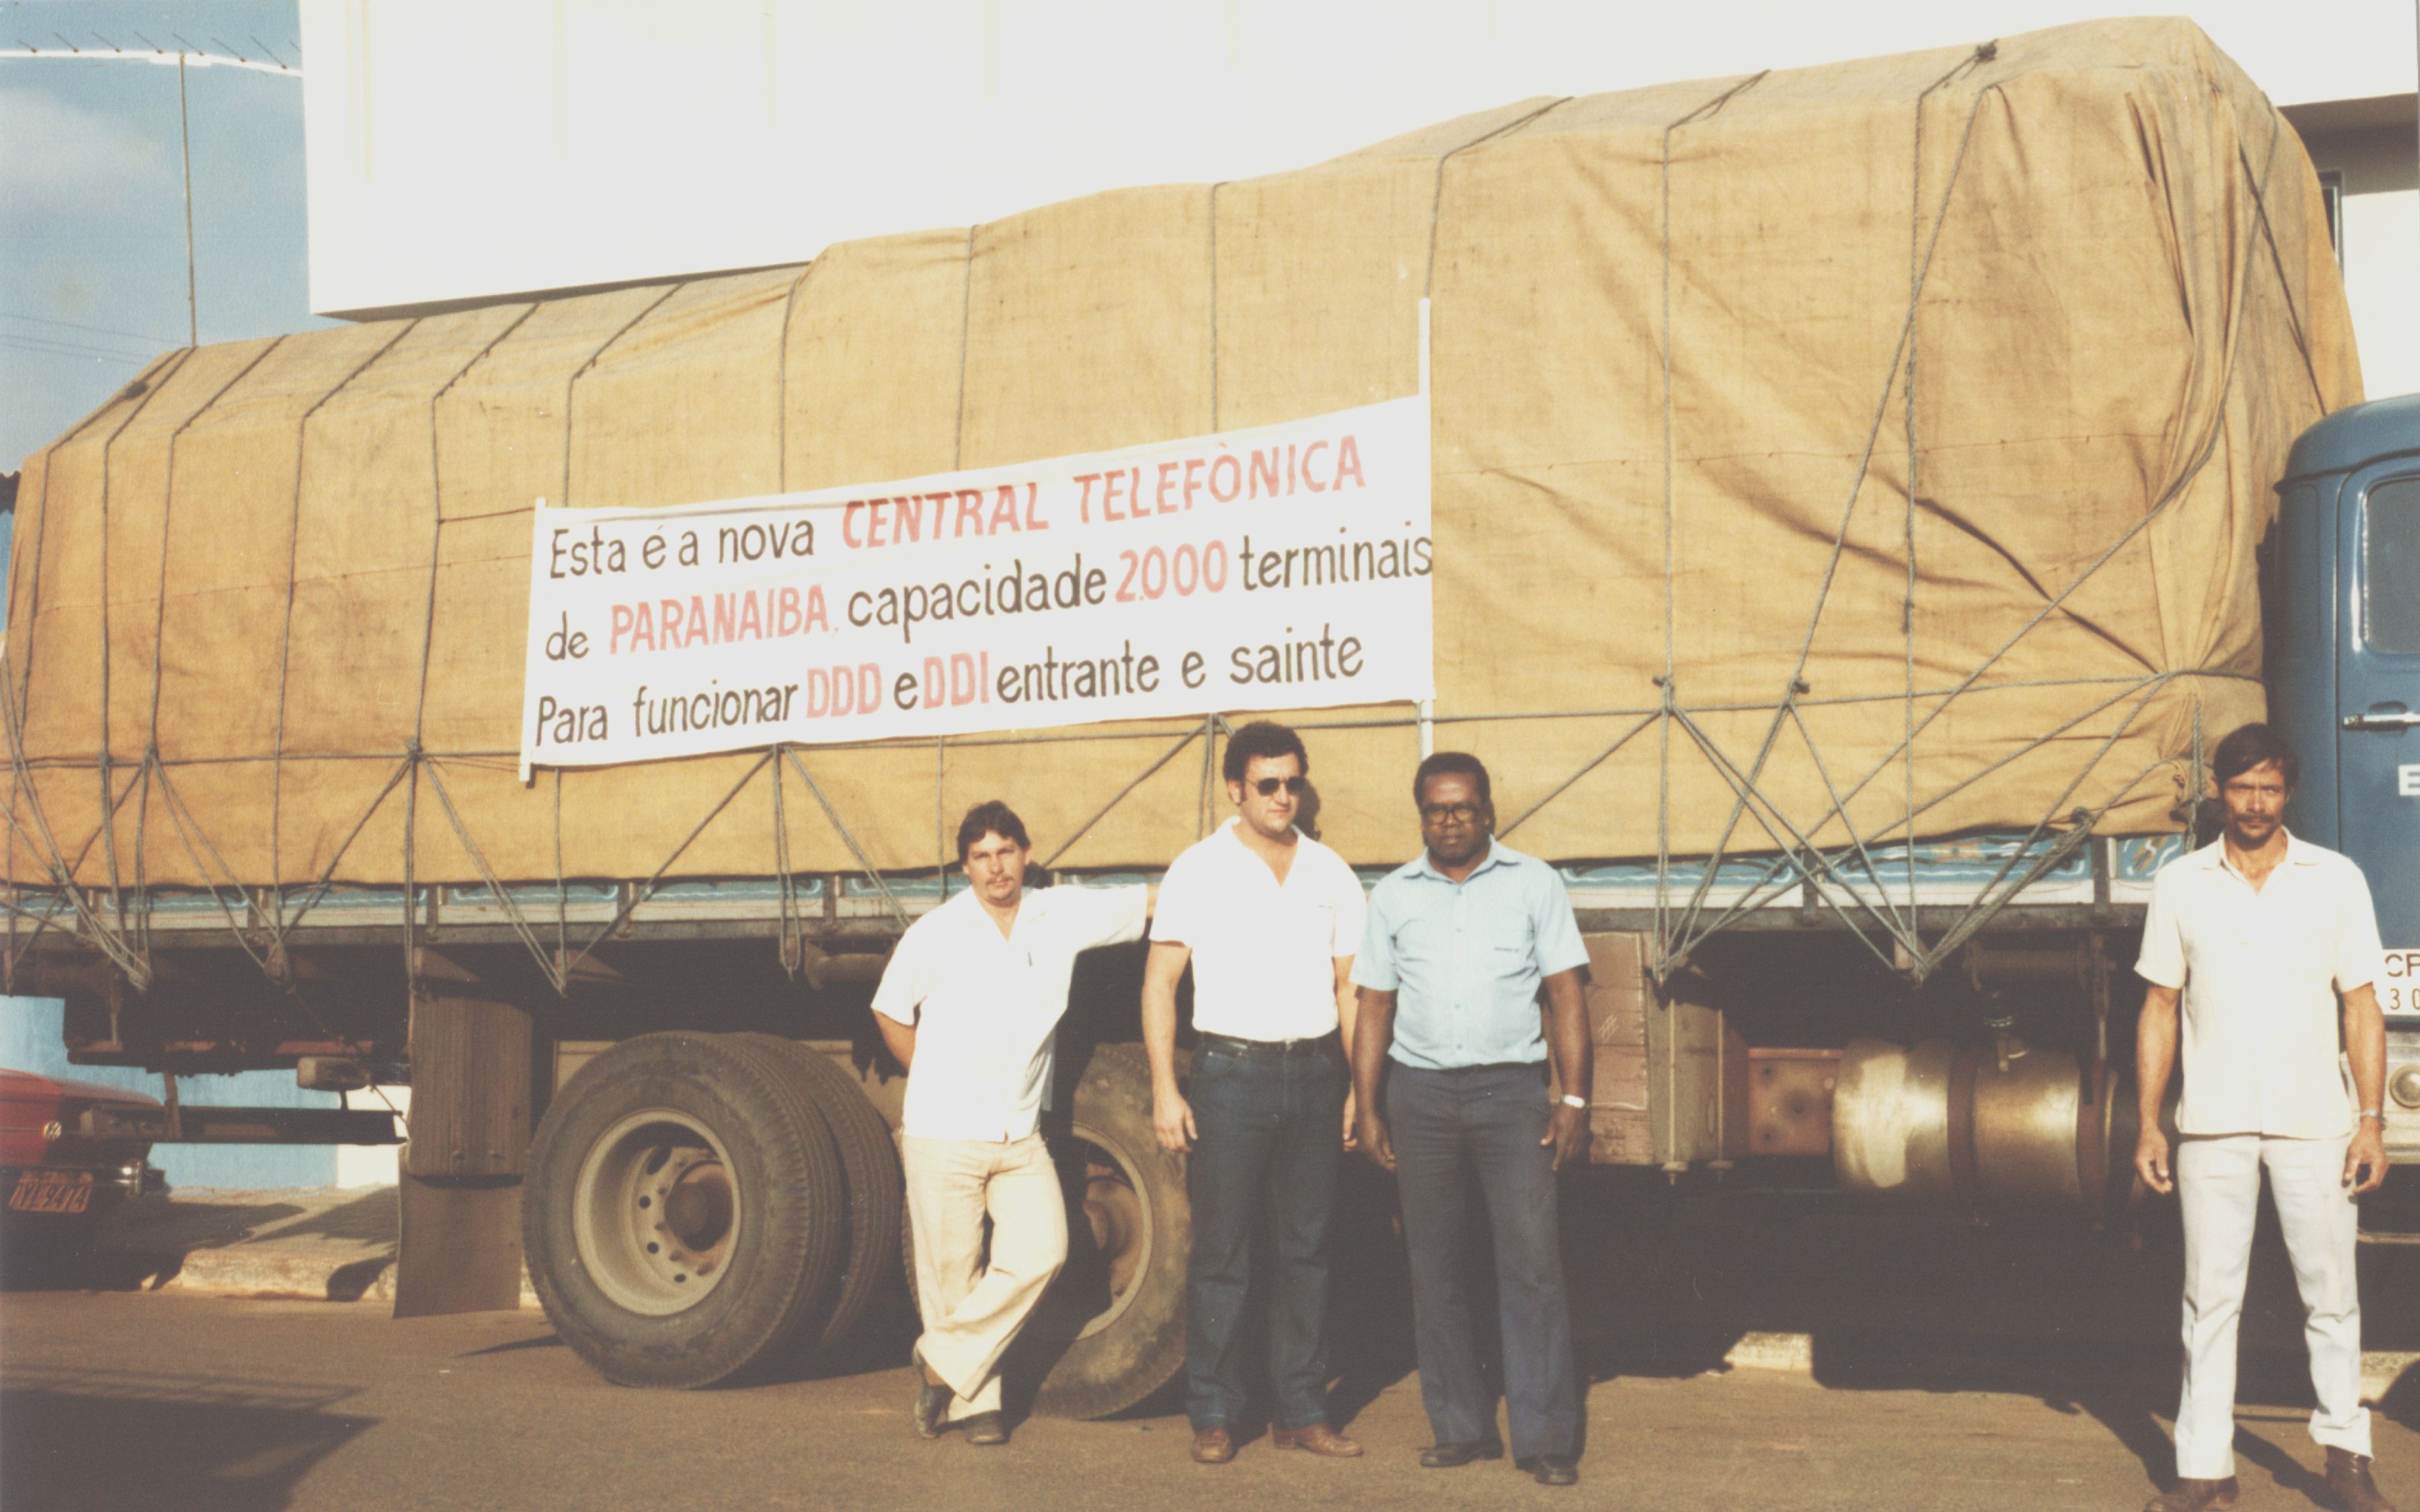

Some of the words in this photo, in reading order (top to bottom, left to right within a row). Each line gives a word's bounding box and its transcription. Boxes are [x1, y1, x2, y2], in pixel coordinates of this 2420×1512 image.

[545, 610, 590, 662] de
[847, 552, 1107, 644] capacidade
[1238, 520, 1434, 592] terminais
[549, 524, 627, 580] Esta
[642, 525, 667, 571] é
[678, 530, 700, 567] a
[718, 519, 815, 564] nova
[842, 480, 1049, 548] CENTRAL
[536, 695, 608, 747] Para
[632, 679, 799, 738] funcionar
[806, 663, 883, 718] DDD
[893, 671, 919, 712] e
[923, 650, 990, 710] DDI
[996, 638, 1160, 704] entrante
[1181, 650, 1207, 689] e
[1229, 622, 1364, 685] sainte
